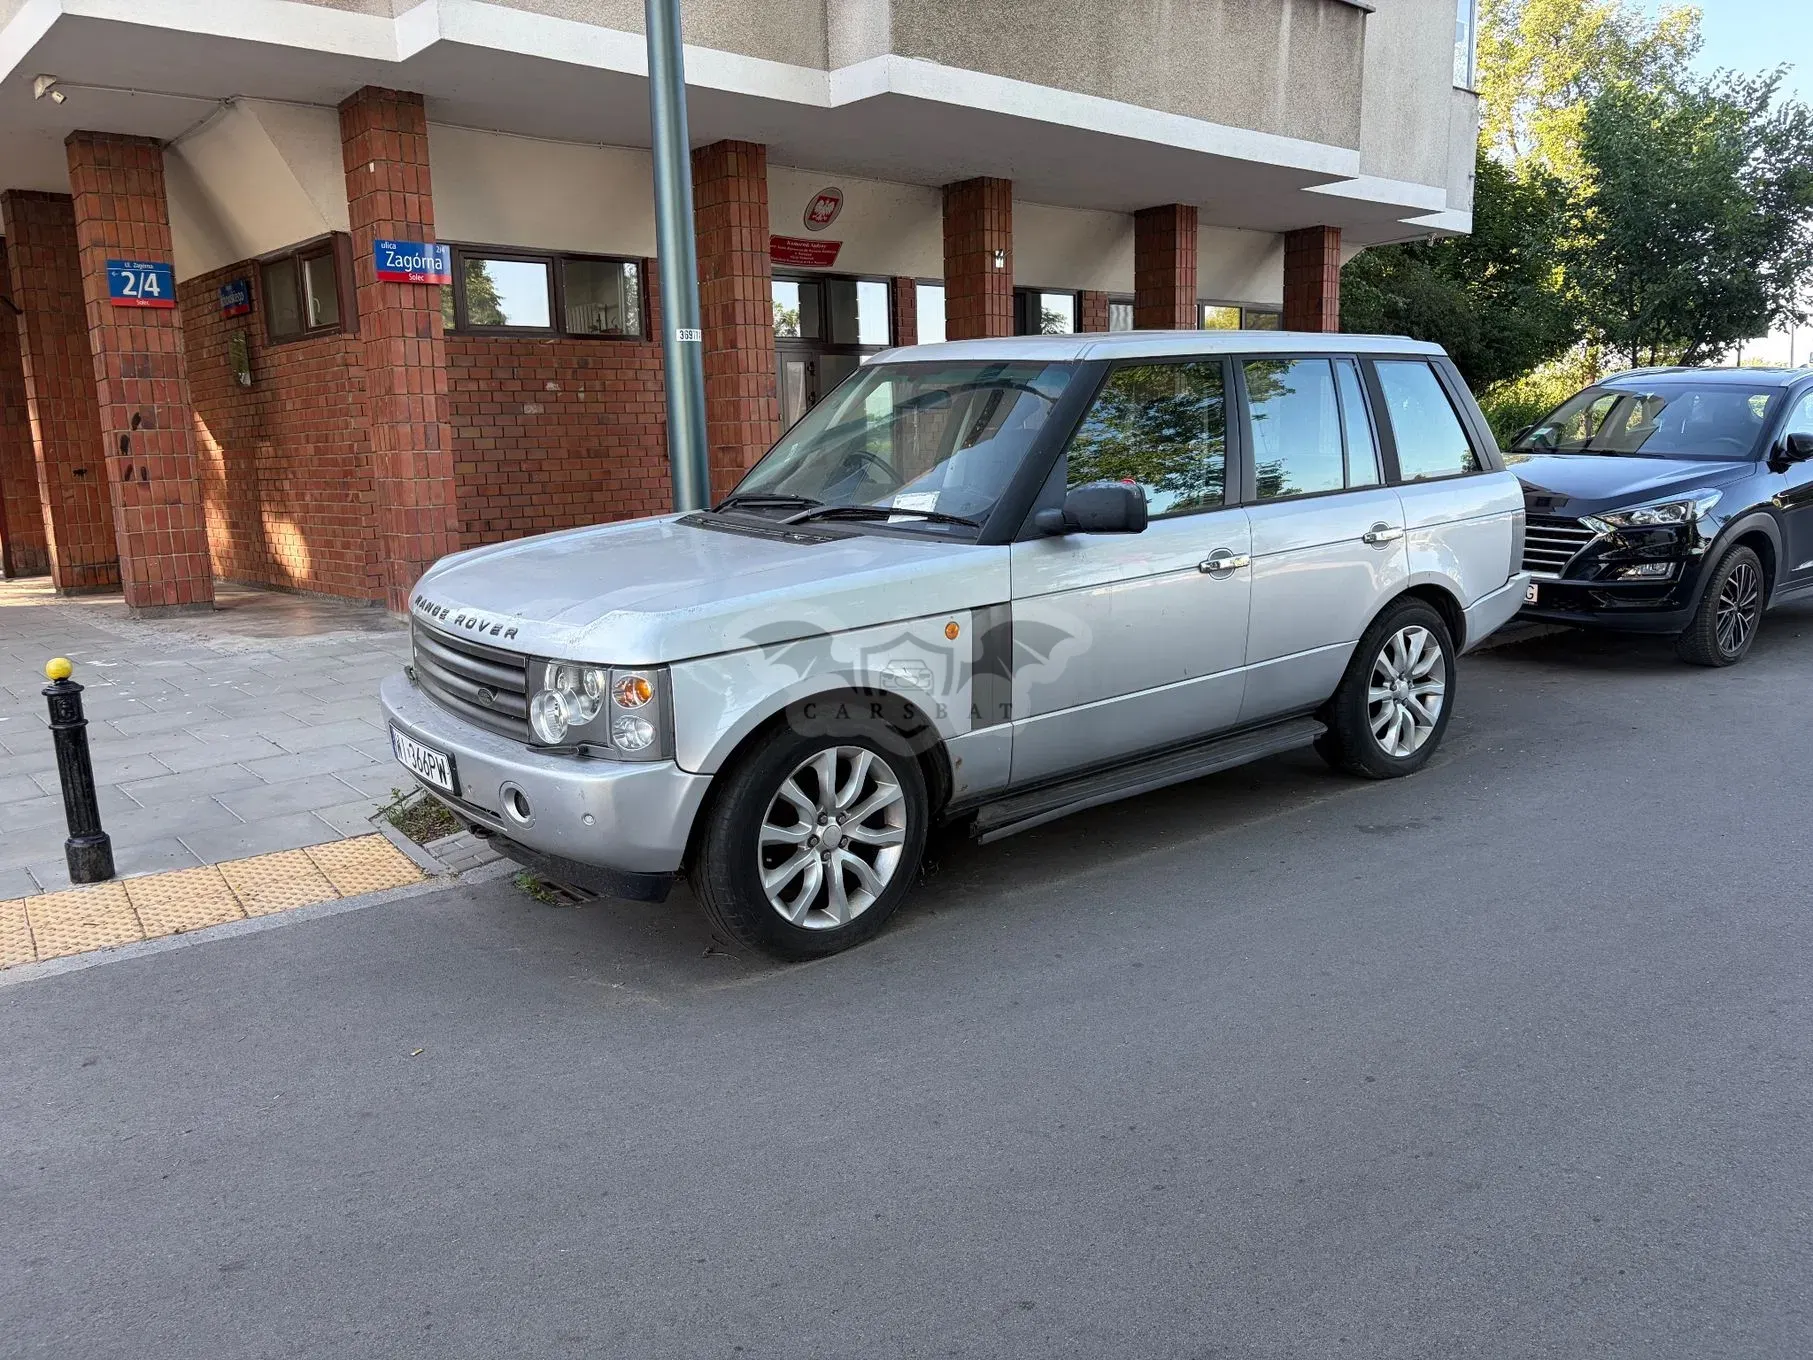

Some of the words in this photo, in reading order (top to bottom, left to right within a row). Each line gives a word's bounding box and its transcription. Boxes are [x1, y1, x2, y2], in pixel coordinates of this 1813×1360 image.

[386, 251, 442, 272] Zagórna
[121, 272, 160, 298] 2/4
[415, 595, 449, 620] RANGE
[454, 614, 518, 640] ROVER
[409, 743, 447, 785] 366PW
